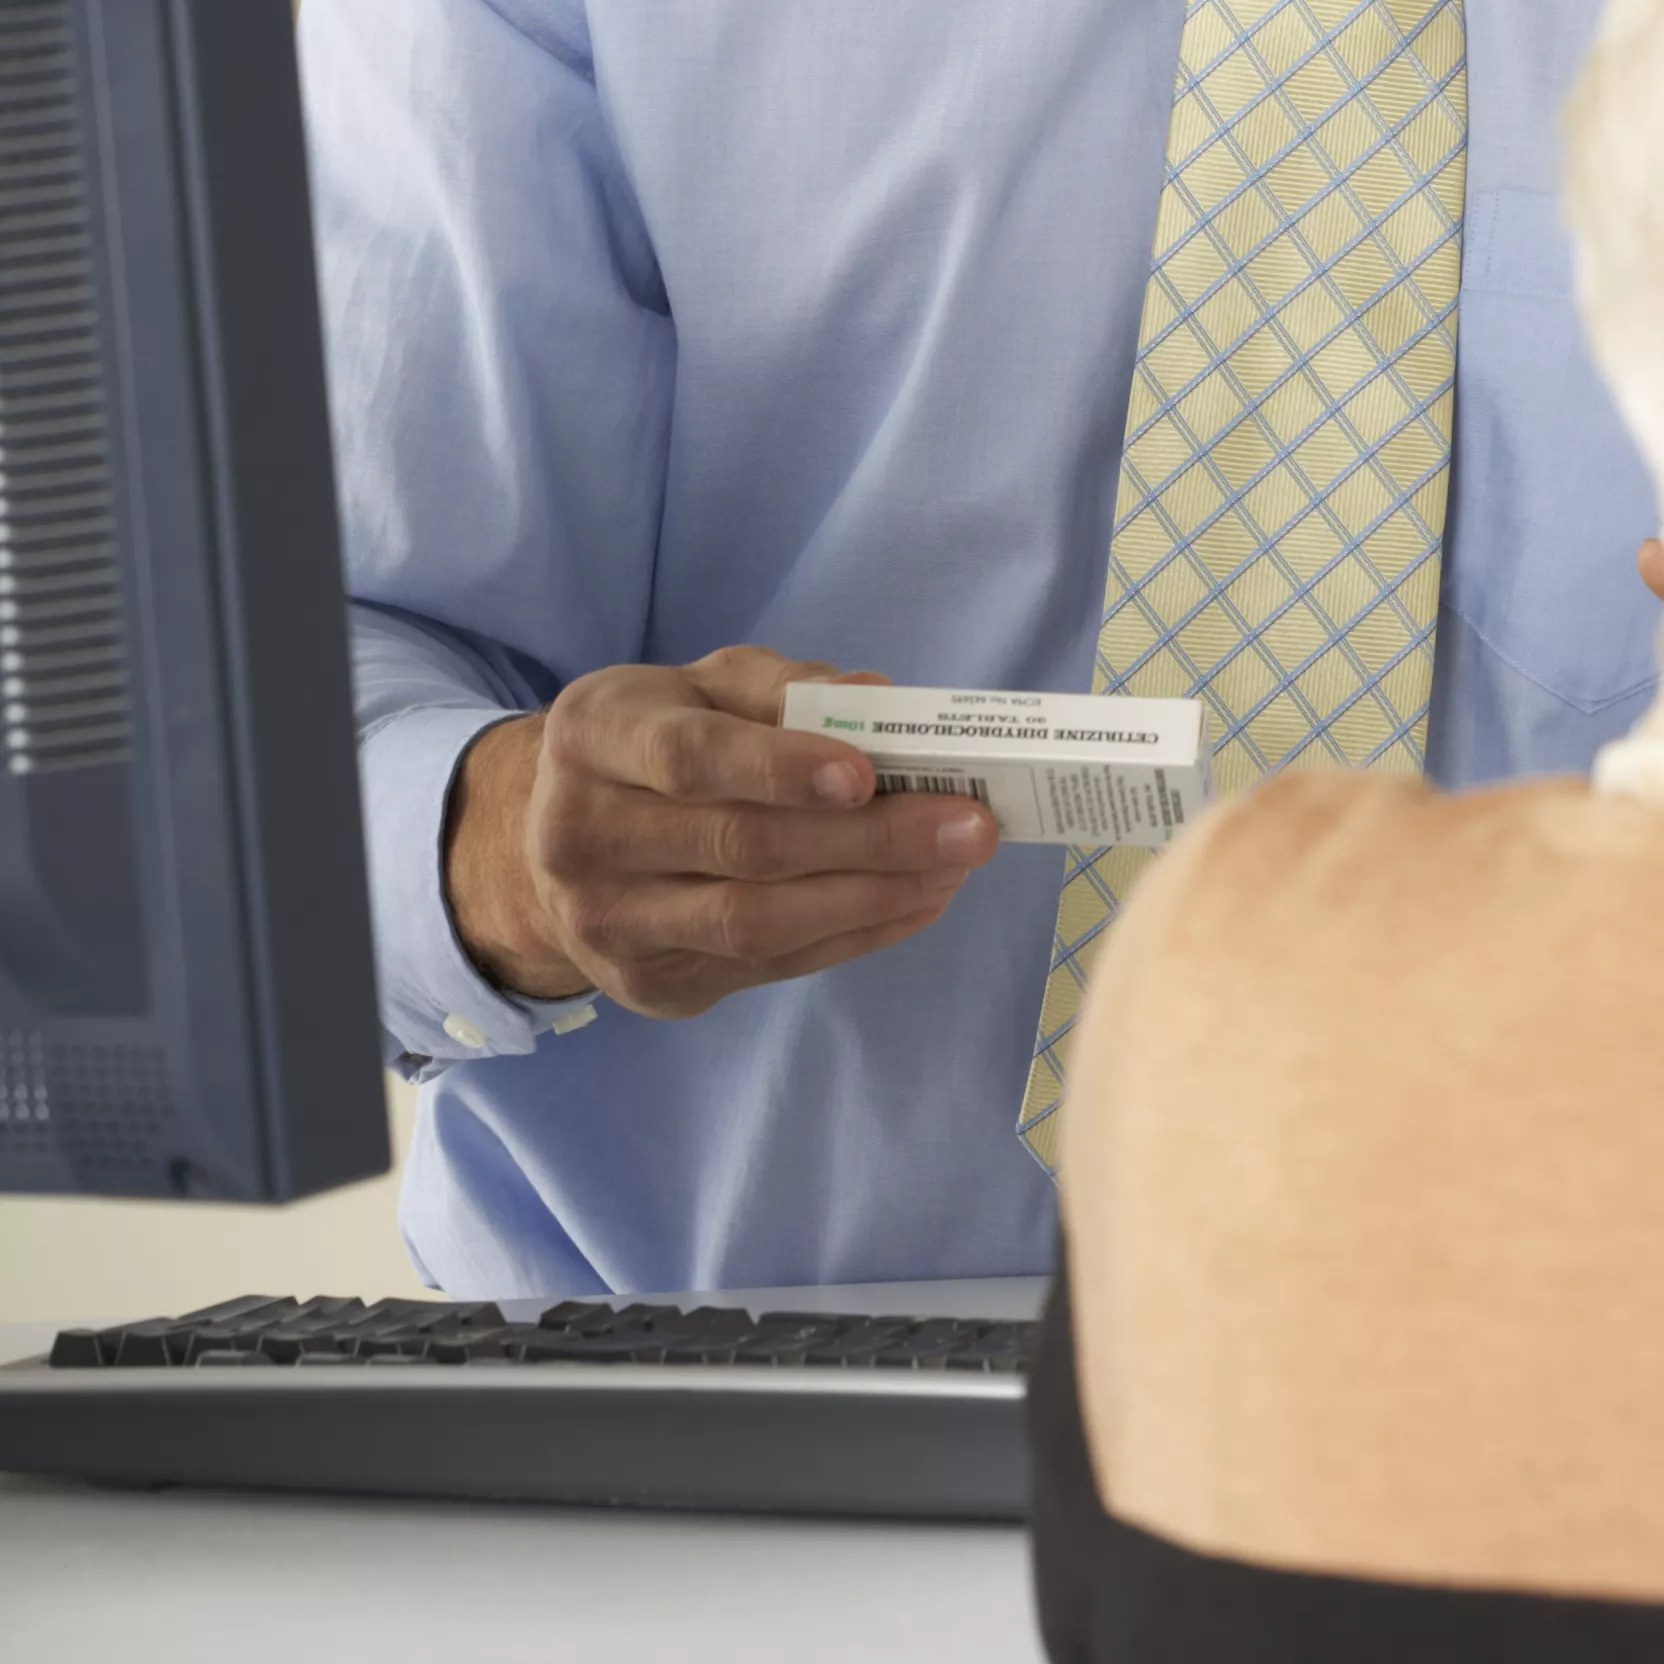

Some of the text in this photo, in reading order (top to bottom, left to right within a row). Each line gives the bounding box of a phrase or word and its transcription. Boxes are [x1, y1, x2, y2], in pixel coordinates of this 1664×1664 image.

[937, 712, 1020, 724] TABLETS
[871, 721, 1049, 740] DIHYDROCHLORIDE
[1054, 727, 1159, 745] CETIRIZINE
